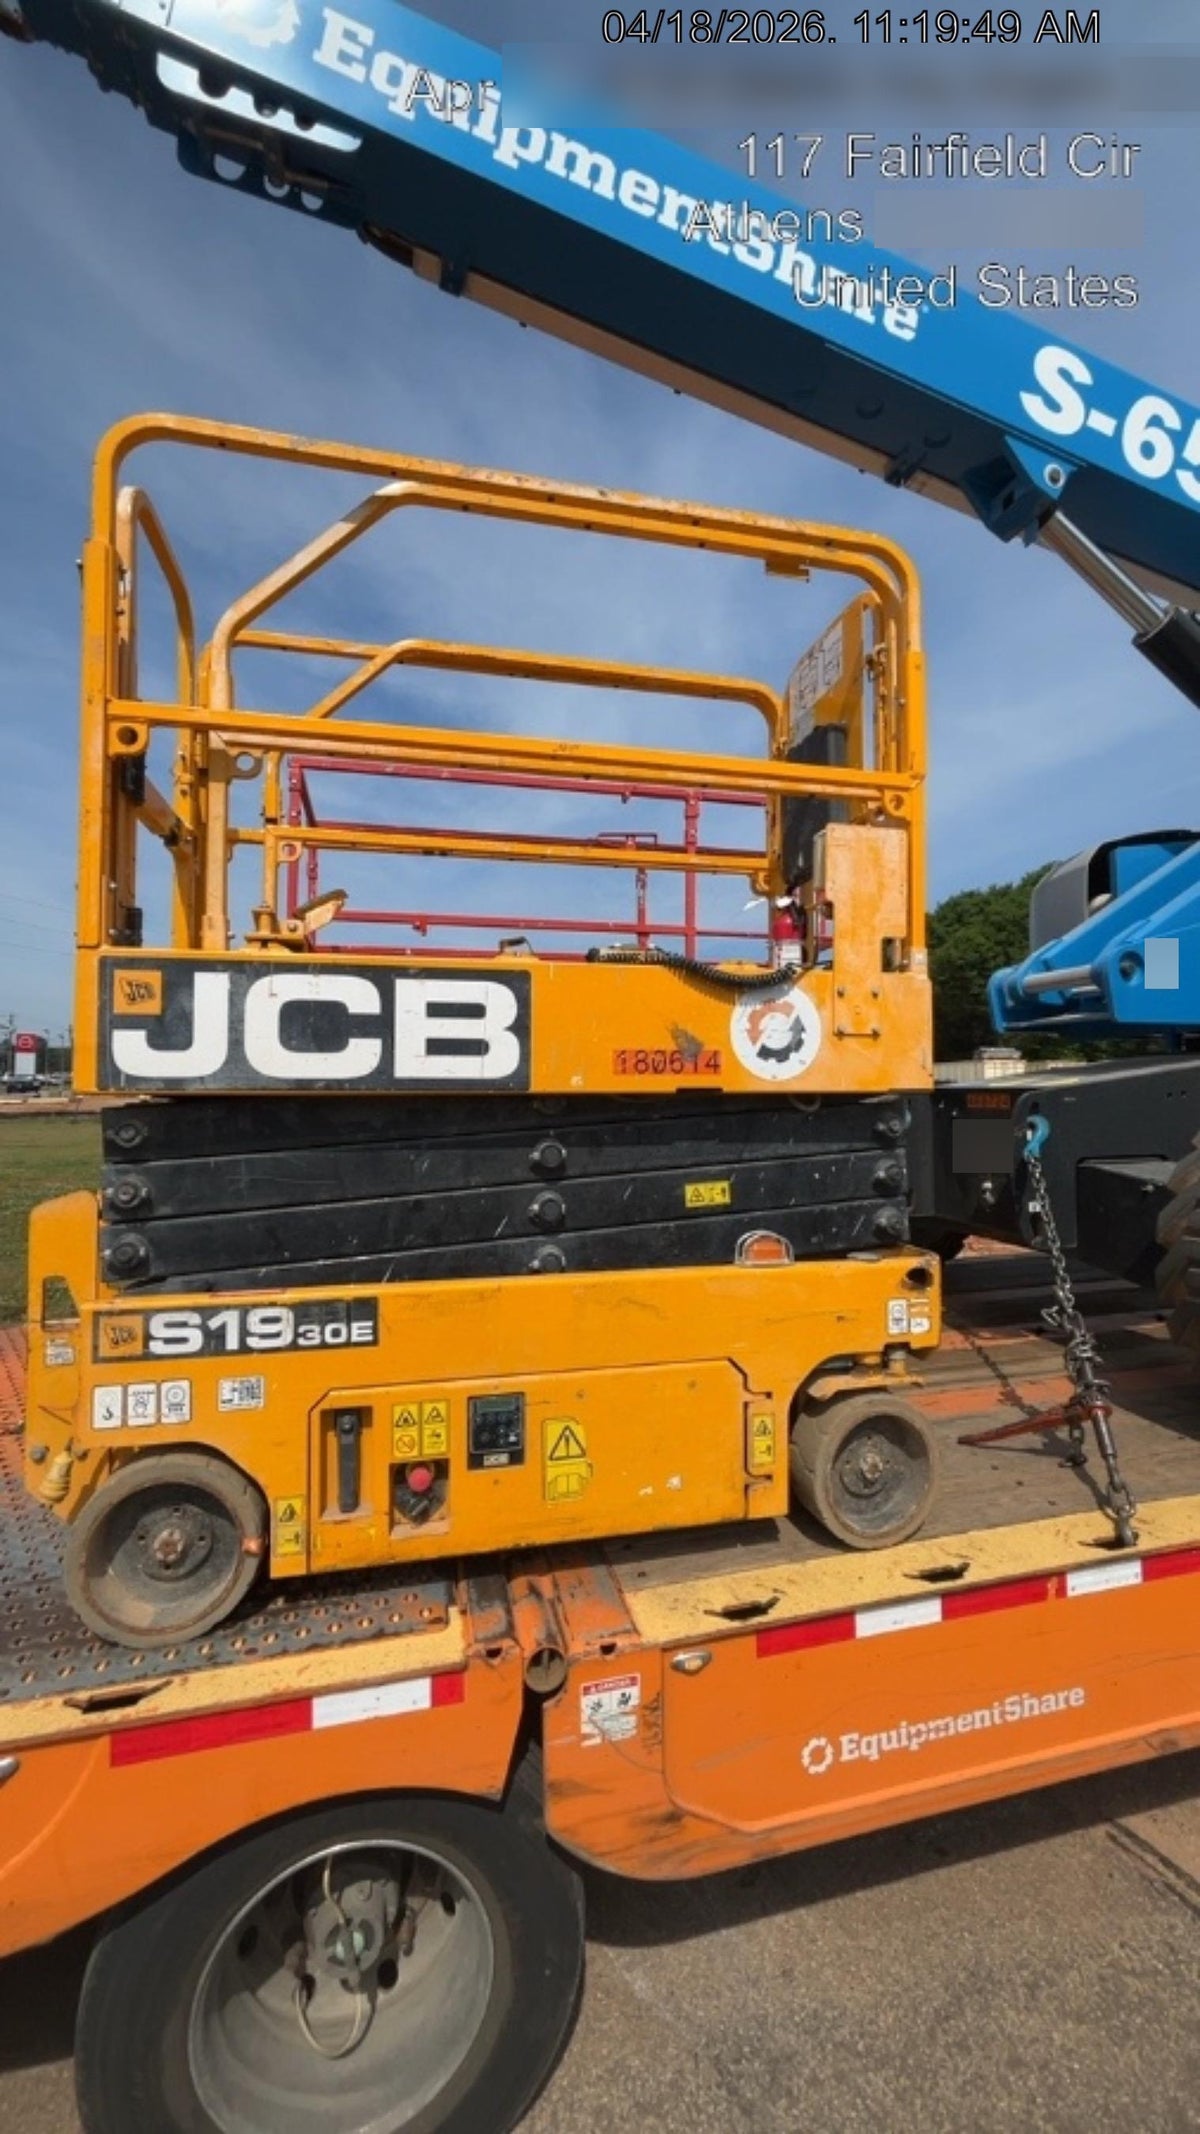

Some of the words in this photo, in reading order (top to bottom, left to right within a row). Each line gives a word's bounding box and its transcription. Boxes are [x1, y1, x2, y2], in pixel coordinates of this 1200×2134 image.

[112, 971, 521, 1079] JCB
[616, 1049, 720, 1075] 180614
[839, 1687, 1085, 1763] EquipmentShare
